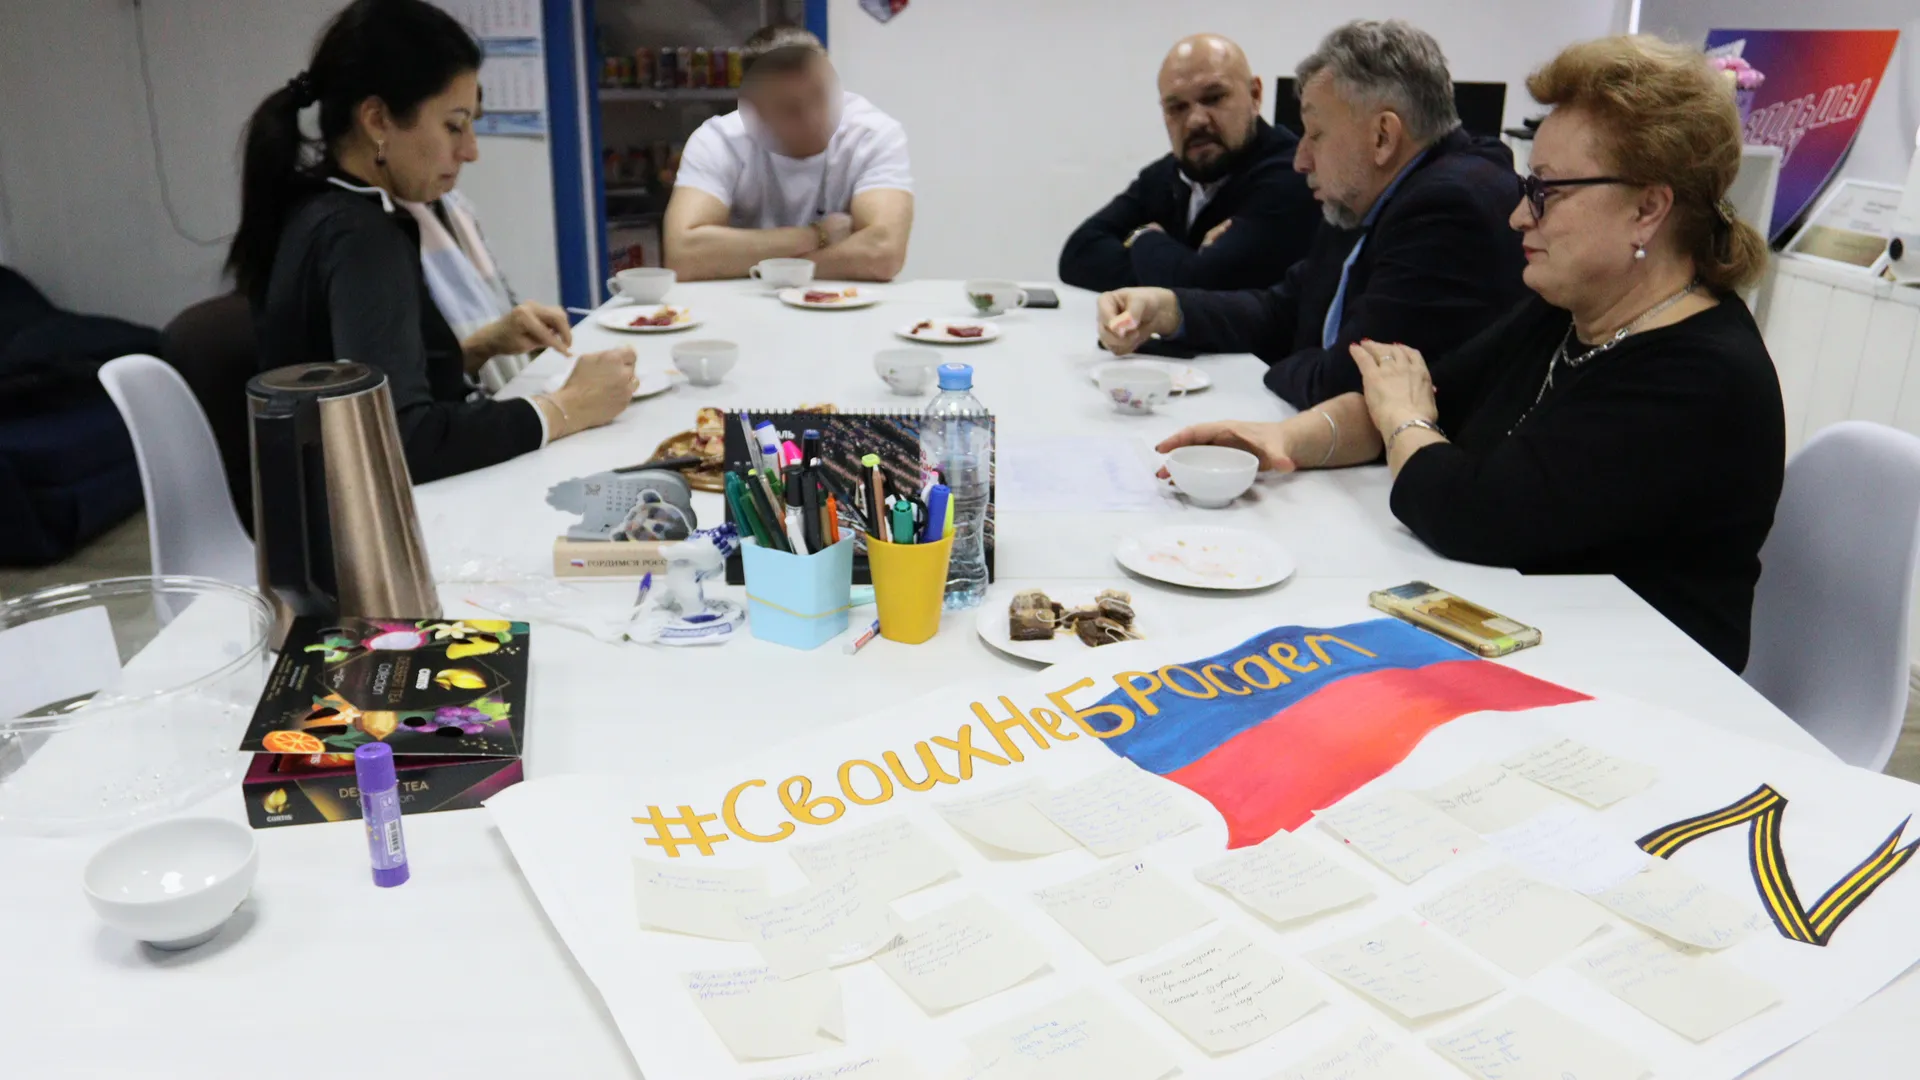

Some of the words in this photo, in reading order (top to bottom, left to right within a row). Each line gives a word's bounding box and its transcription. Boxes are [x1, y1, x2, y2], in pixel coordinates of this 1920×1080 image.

[587, 559, 640, 568] ГОРДИМСЯ
[642, 558, 668, 567] РОСС
[402, 780, 430, 793] TEA
[266, 813, 293, 823] CURTIS
